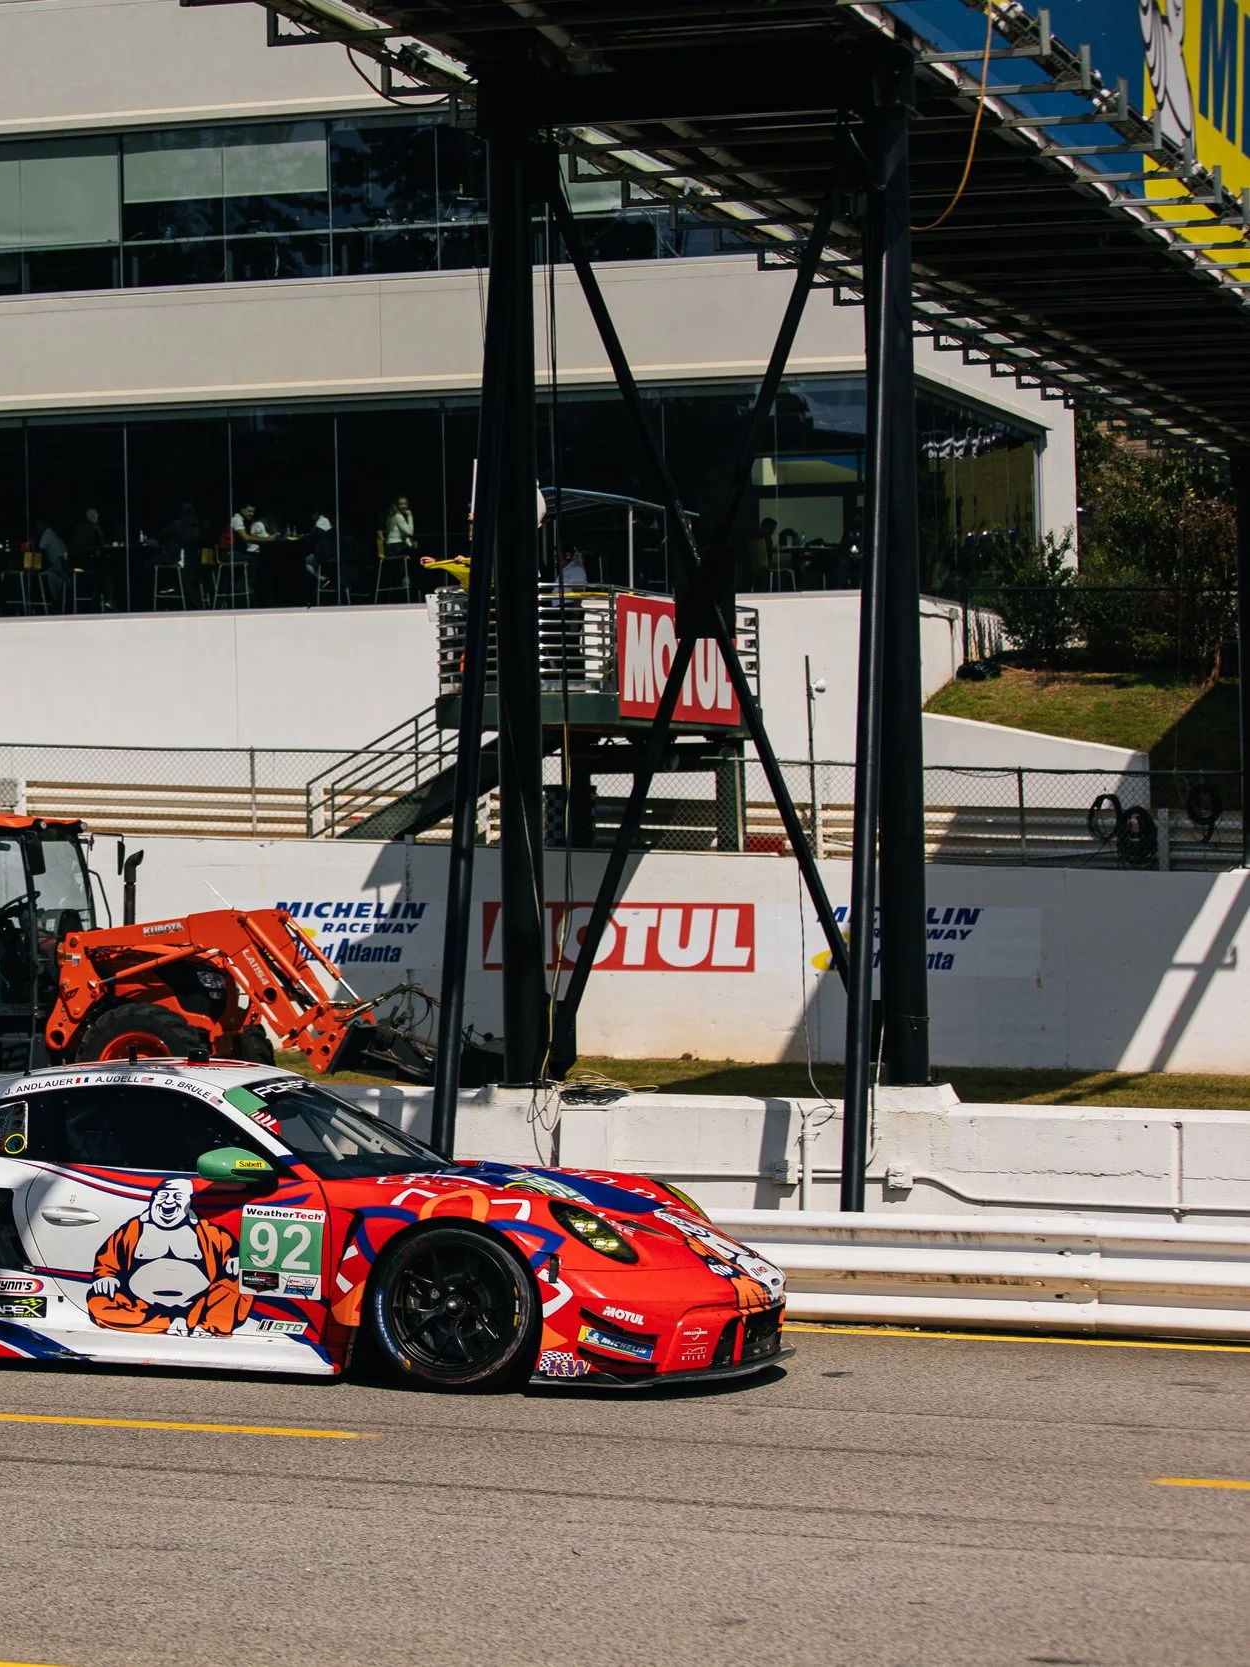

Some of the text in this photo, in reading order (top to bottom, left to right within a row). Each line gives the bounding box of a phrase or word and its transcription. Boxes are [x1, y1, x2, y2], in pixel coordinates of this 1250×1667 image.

[143, 922, 183, 936] KUBOTA
[322, 923, 419, 934] RACEWAY
[333, 938, 402, 965] Atlanta
[16, 1078, 74, 1093] ANDLAUER
[95, 1075, 139, 1083] A.UDELL
[164, 1078, 175, 1087] D.
[239, 1160, 262, 1168] Sabelt
[246, 1207, 323, 1221] WeatherTech
[250, 1221, 312, 1271] 92
[602, 1305, 644, 1326] MOTUL
[273, 1323, 304, 1332] GTD
[600, 1337, 648, 1355] MICHELIN
[547, 1359, 592, 1377] KW
